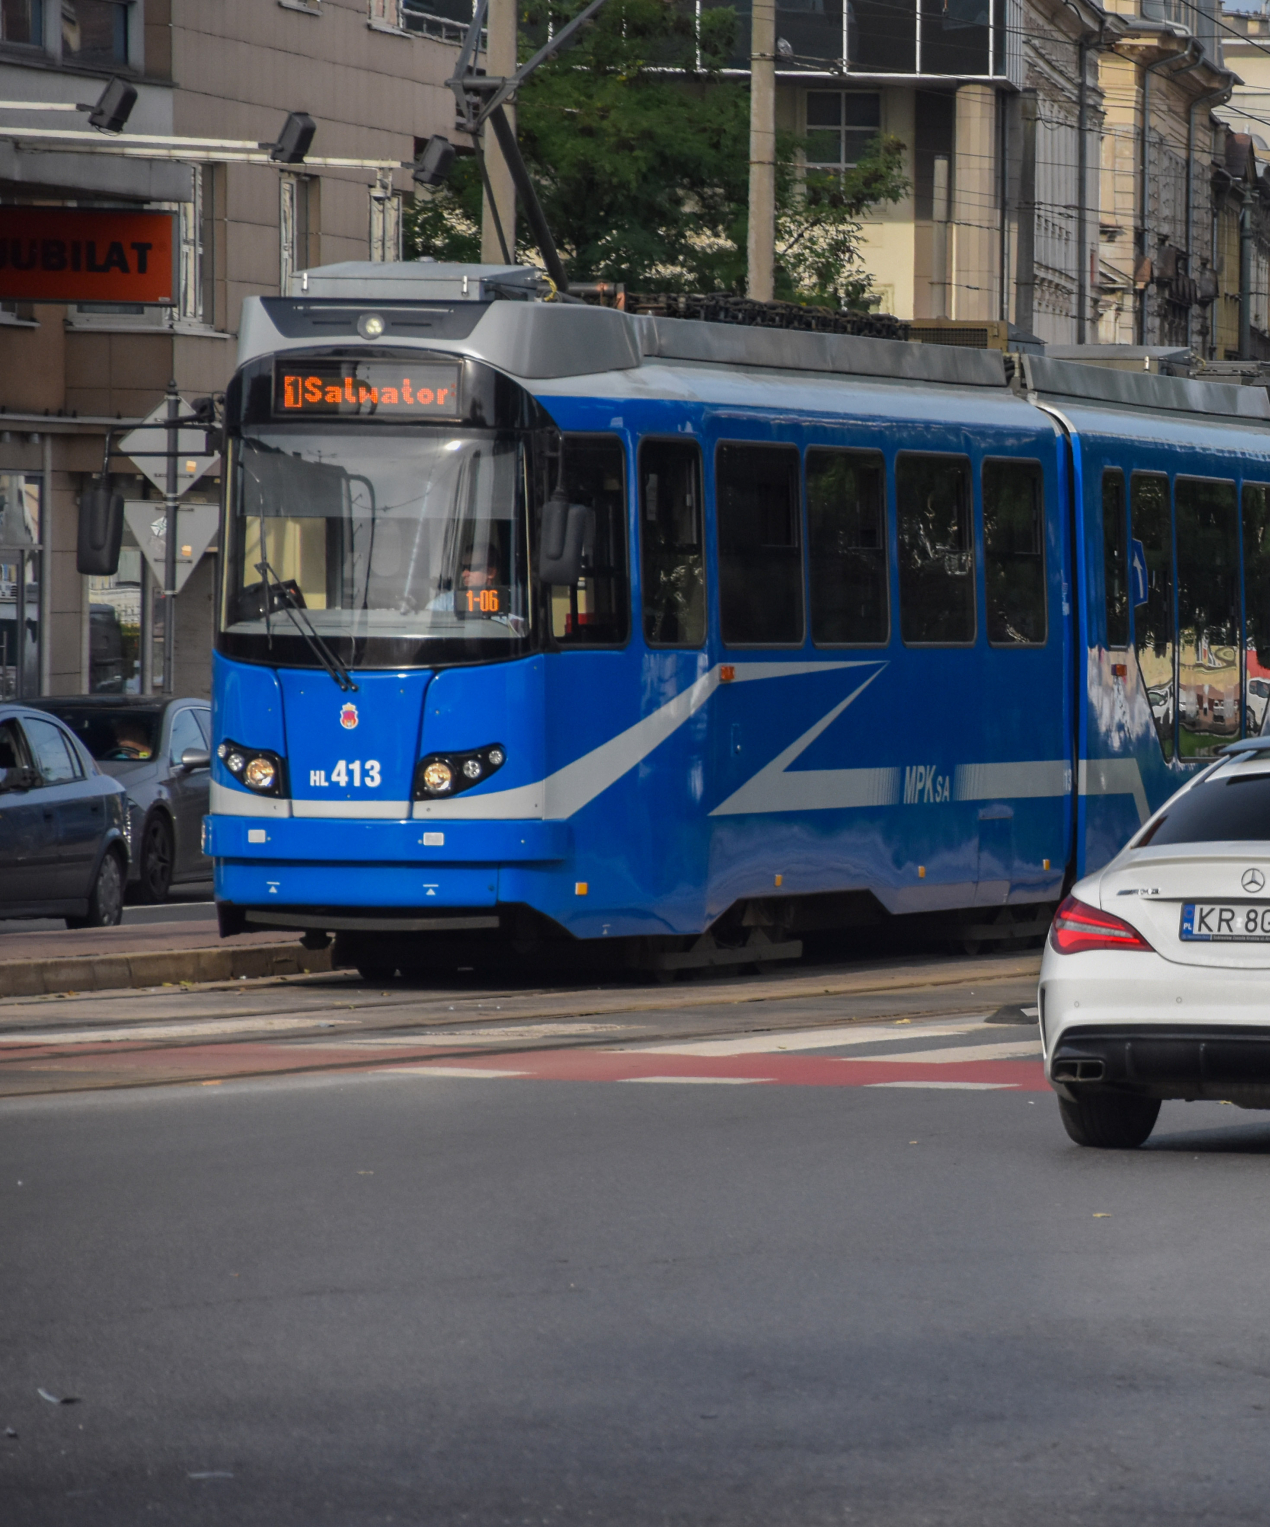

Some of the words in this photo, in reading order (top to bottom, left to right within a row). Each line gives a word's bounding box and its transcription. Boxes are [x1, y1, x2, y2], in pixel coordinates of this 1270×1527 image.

[304, 376, 449, 405] Salwator
[466, 589, 499, 612] 1-06
[309, 770, 329, 787] HL
[331, 759, 381, 788] 413
[903, 764, 937, 804] MPK
[935, 775, 950, 803] SA
[1183, 922, 1193, 931] PL
[1197, 907, 1236, 933] KR
